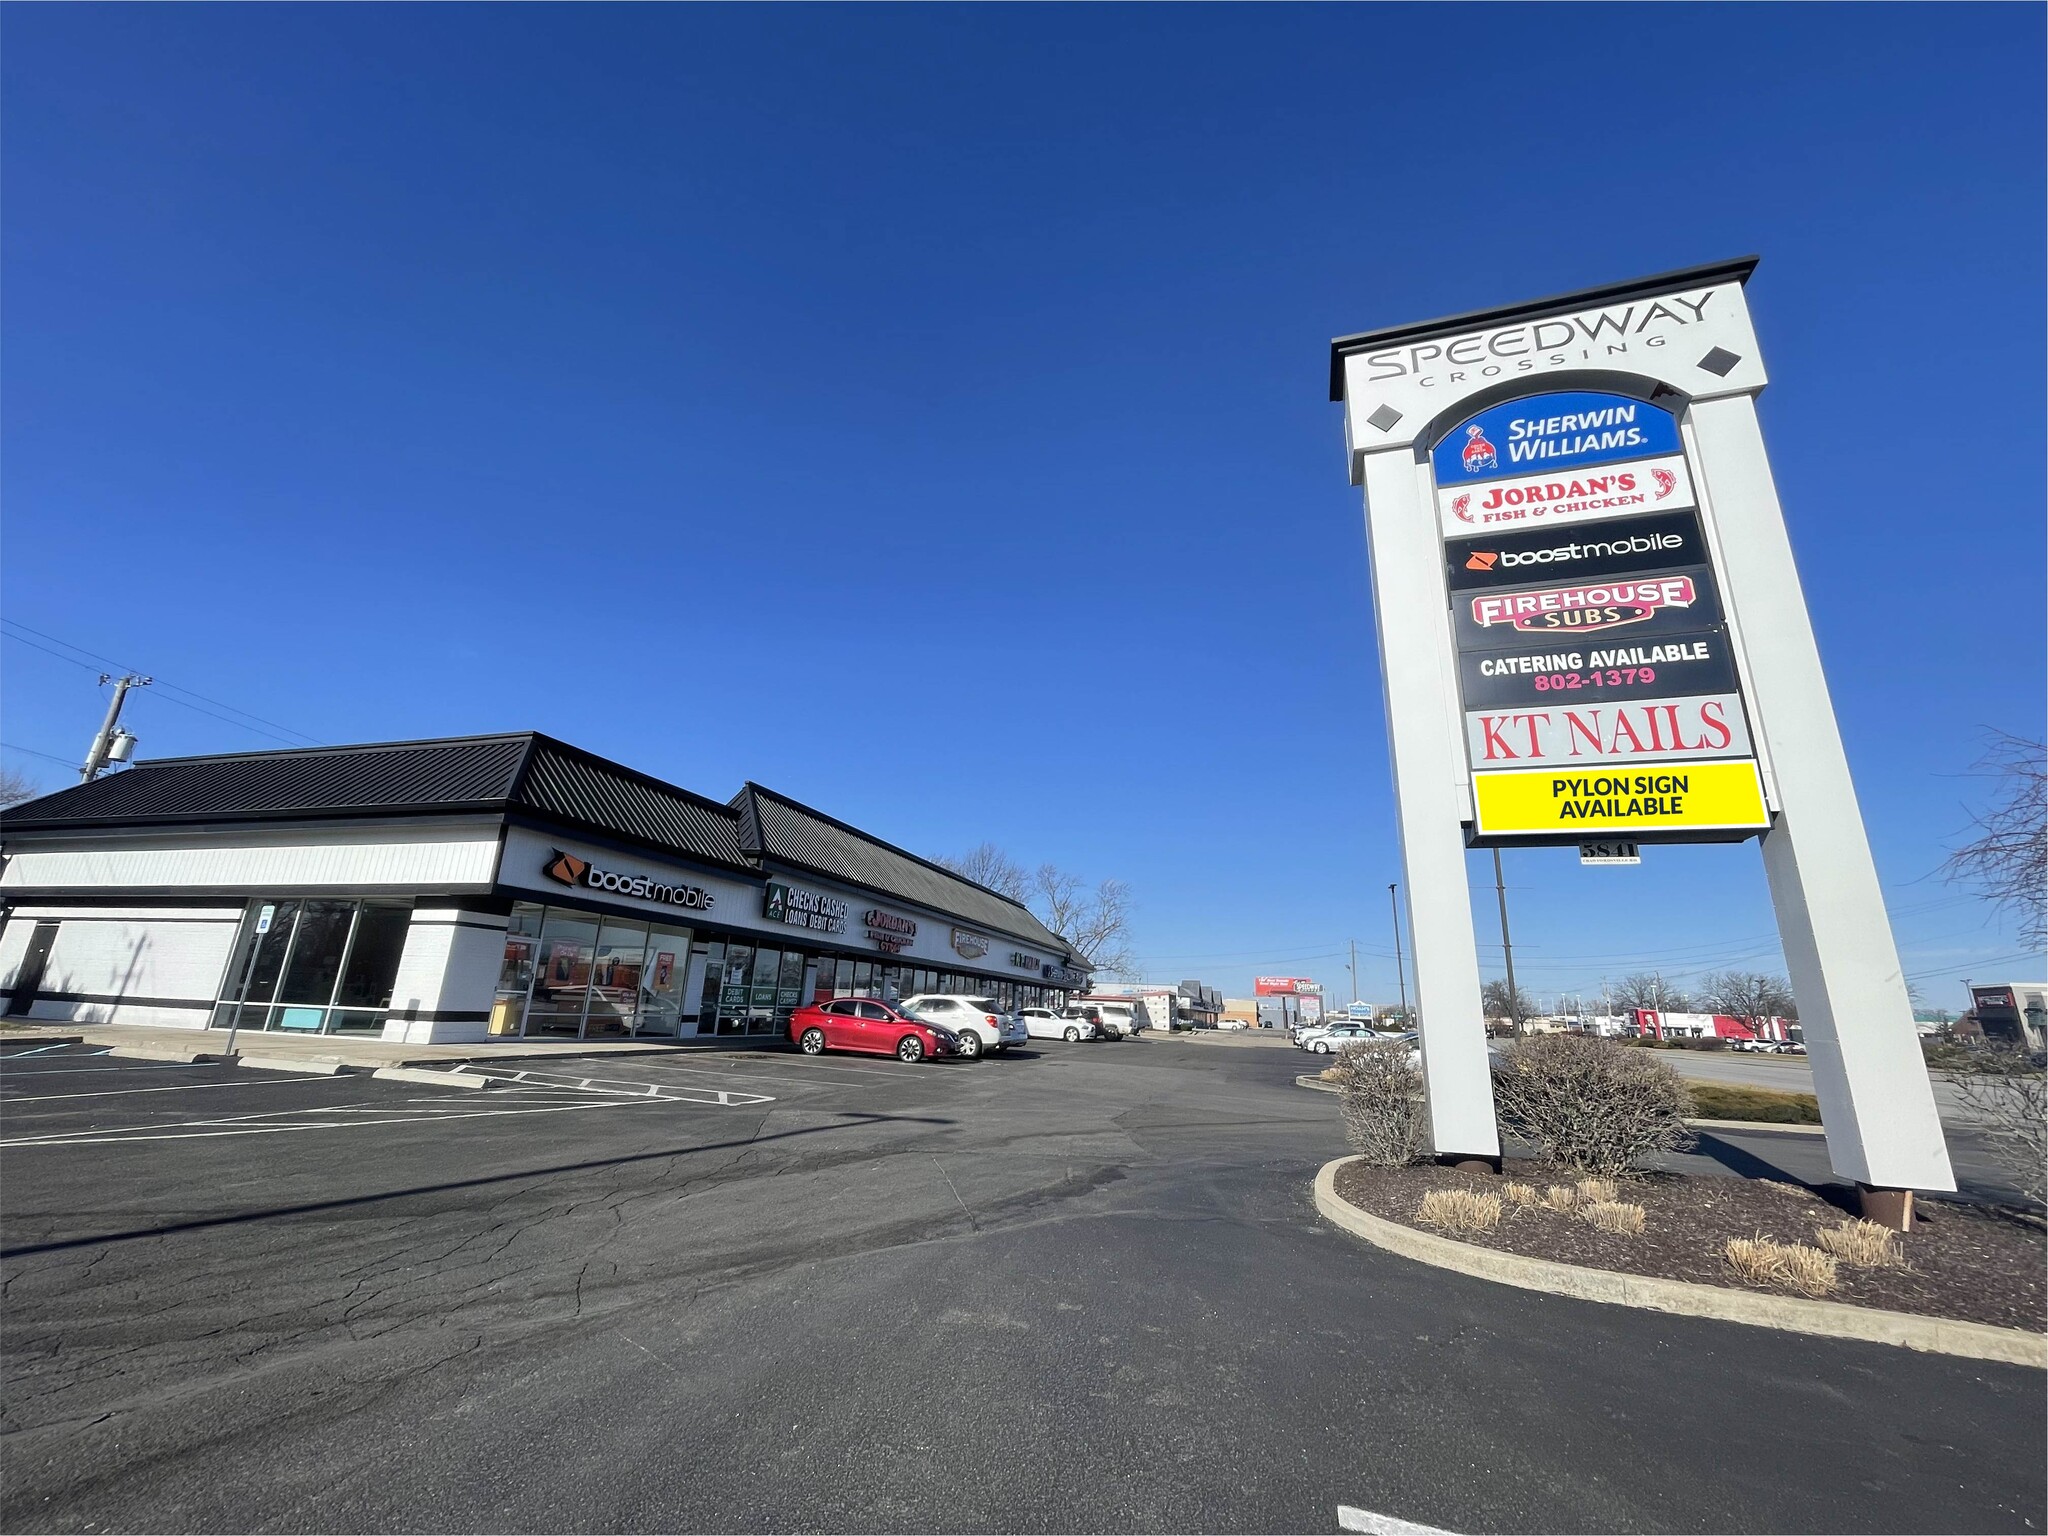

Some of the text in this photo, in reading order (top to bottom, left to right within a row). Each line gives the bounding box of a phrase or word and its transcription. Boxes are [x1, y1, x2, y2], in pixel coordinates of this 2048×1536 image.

[1367, 291, 1715, 381] SPEEDWAY
[1419, 335, 1666, 387] CROSSING
[1508, 405, 1636, 441] SHERWIN
[1482, 473, 1636, 510] JORDAN'S
[1483, 493, 1645, 524] FISH & CHICKEN
[1500, 533, 1683, 567] boostmobile
[1480, 580, 1690, 628] FIREHOUSE
[1546, 606, 1621, 627] SUBS
[1480, 642, 1710, 677] CATERING AVAILABLE
[1534, 667, 1656, 691] 802-1379
[1478, 701, 1732, 760] KT NAILS
[1552, 775, 1689, 798] PYLON SIGN
[1559, 796, 1684, 819] AVAILABLE
[1582, 843, 1636, 858] 5841
[587, 864, 716, 911] boostmobile
[768, 910, 781, 919] ACE
[786, 887, 849, 920] CHECKS CASHED
[784, 908, 847, 934] LOANS DEBIT CARDS
[955, 931, 989, 955] FIREHOUSE
[727, 988, 744, 996] DEBIT
[755, 993, 772, 1001] LOANS
